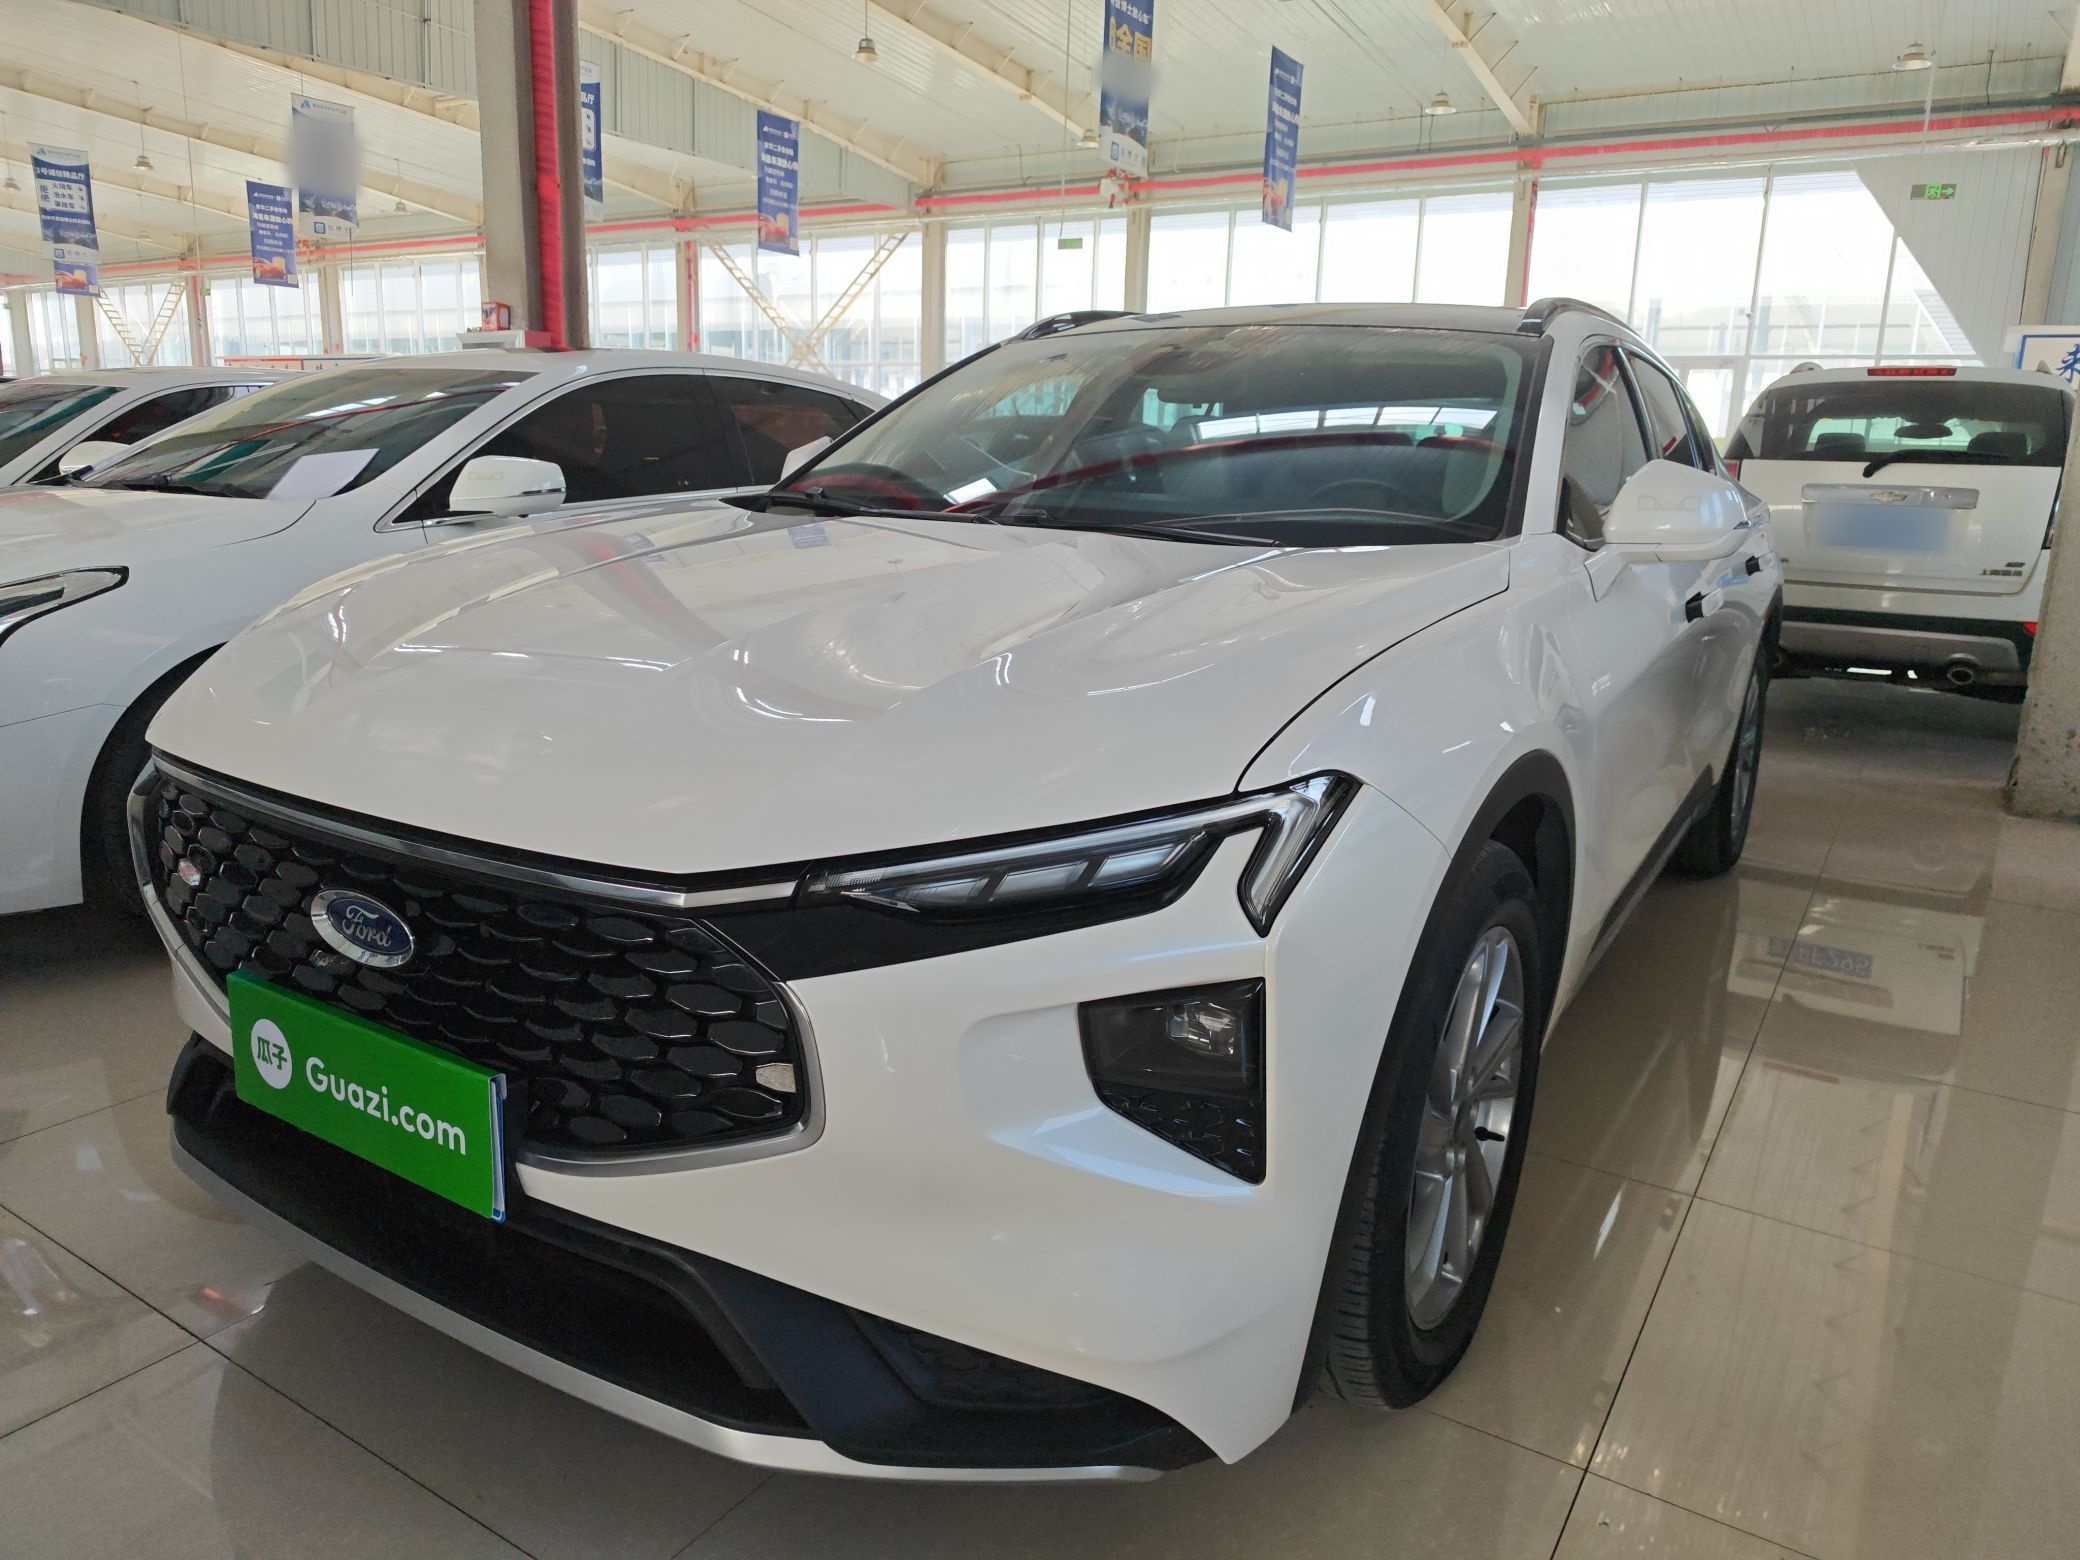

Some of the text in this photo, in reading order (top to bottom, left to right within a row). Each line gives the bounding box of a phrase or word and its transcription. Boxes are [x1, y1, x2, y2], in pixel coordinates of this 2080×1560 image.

[342, 904, 392, 948] Ford
[257, 1036, 288, 1071] 瓜子
[305, 1056, 467, 1156] Guazi.com
